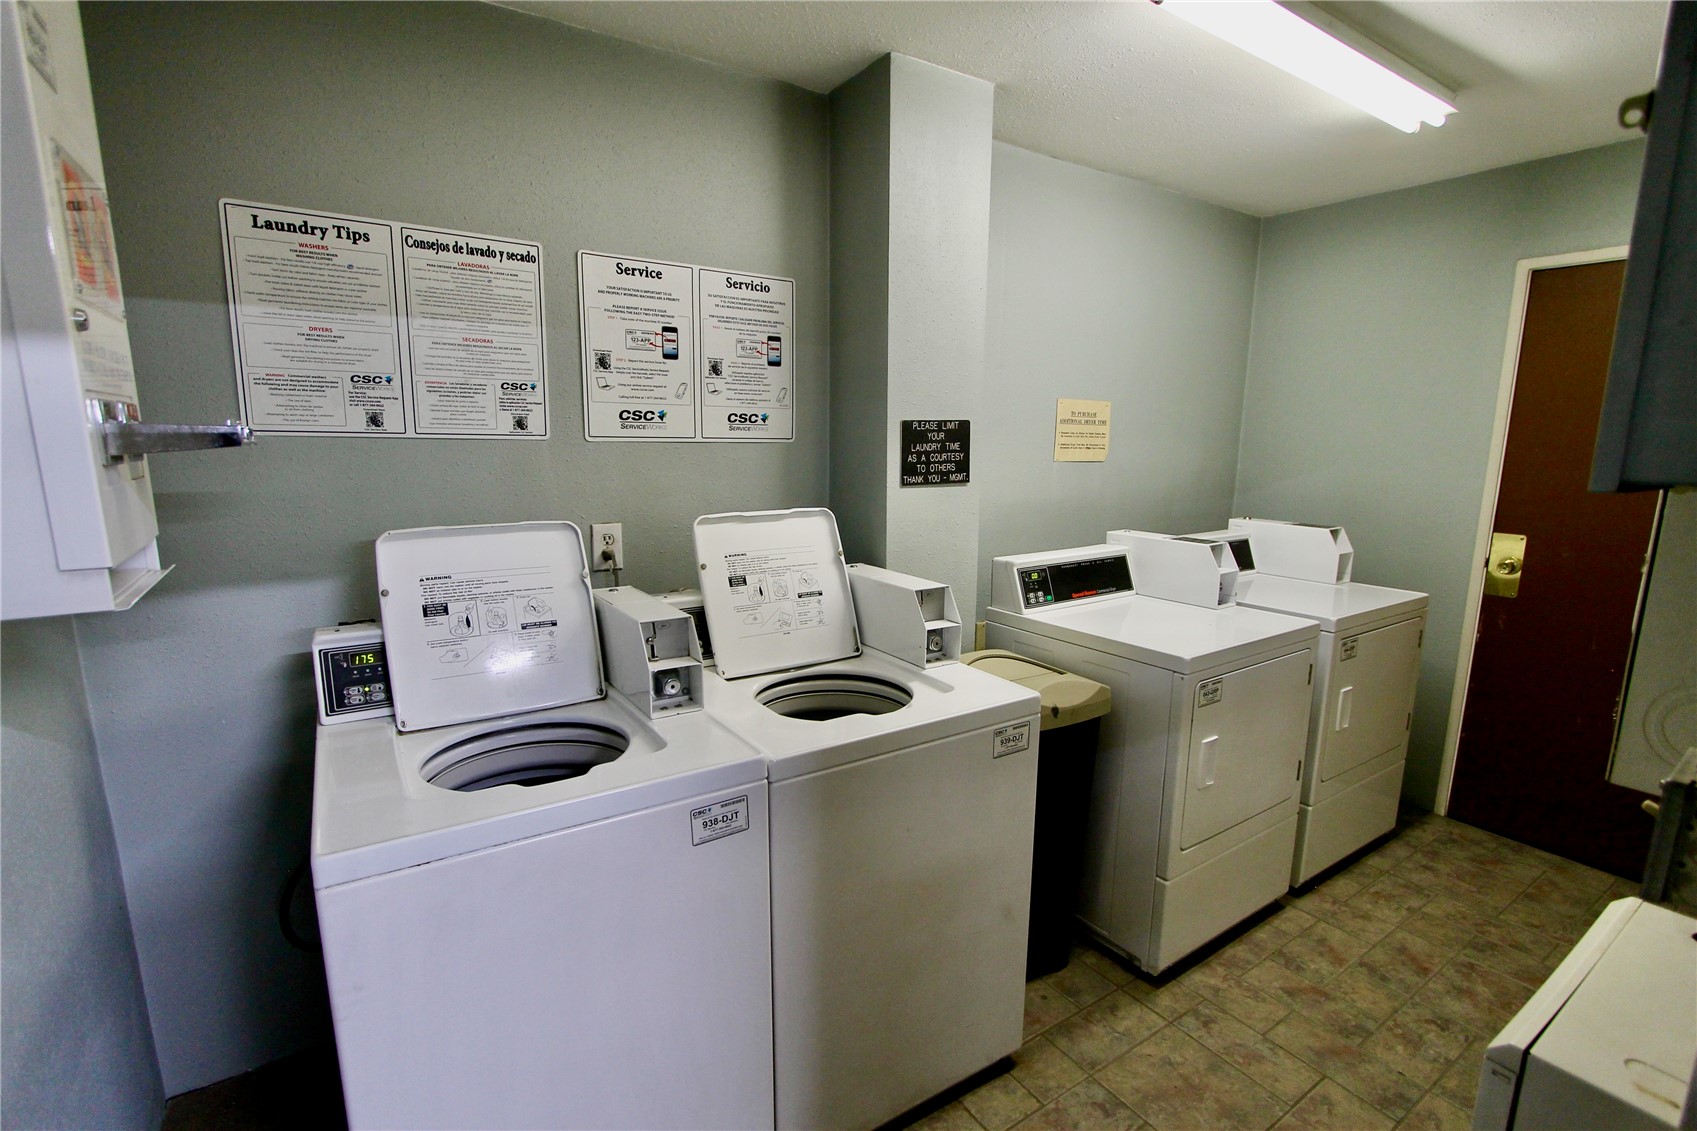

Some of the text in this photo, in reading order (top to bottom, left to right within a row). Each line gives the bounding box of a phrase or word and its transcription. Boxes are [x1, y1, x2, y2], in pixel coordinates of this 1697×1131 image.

[251, 214, 370, 245] Laundry Tips
[298, 242, 329, 250] WASHERS
[404, 234, 536, 264] Consejos de lavado y secado
[457, 261, 489, 270] LAVADORAS
[615, 262, 662, 279] Service
[725, 276, 770, 293] Servicio
[349, 374, 382, 384] CSC
[500, 382, 528, 390] CSC
[618, 409, 655, 420] CSC
[727, 413, 758, 423] CSC
[911, 443, 941, 451] LAUNDRY
[930, 452, 964, 461] COURTESY
[930, 463, 956, 472] OTHERS
[903, 475, 924, 484] THANK
[949, 473, 969, 481] MGMT.
[355, 654, 374, 664] 175
[1000, 733, 1024, 745] 939-DJT
[692, 809, 707, 817] CSC
[702, 811, 739, 828] 938-DJT
